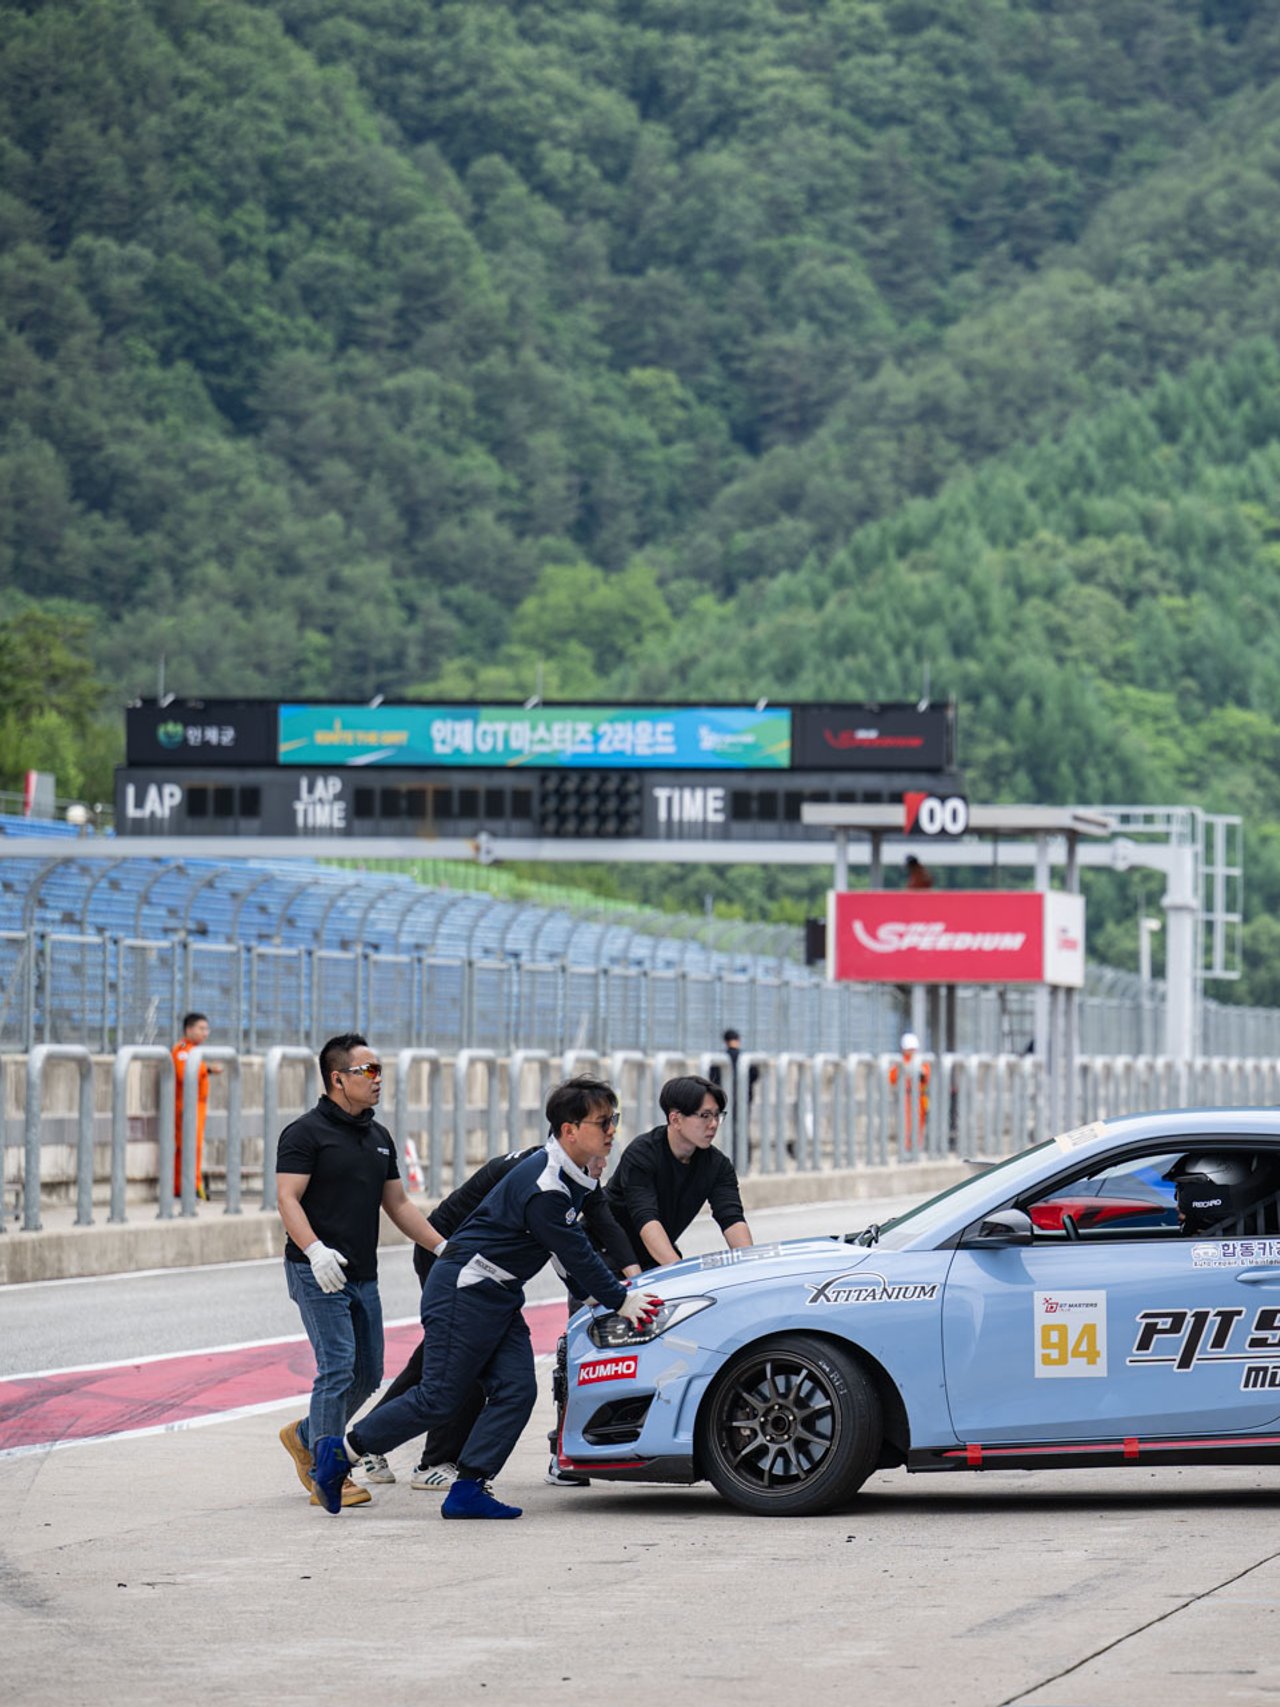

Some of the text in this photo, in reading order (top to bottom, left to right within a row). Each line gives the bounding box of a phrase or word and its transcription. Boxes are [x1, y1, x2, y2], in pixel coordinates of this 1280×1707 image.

[430, 718, 473, 754] 인제
[476, 722, 508, 752] GT
[597, 719, 677, 755] 2라운드
[126, 783, 183, 819] LAP
[300, 775, 343, 801] LAP
[653, 787, 726, 823] TIME
[293, 800, 347, 829] TIME
[917, 797, 968, 835] 00
[853, 920, 1027, 953] SPEEDIUM
[1041, 1323, 1101, 1366] 94
[1134, 1308, 1245, 1370] PIT
[579, 1361, 636, 1380] KUMHO
